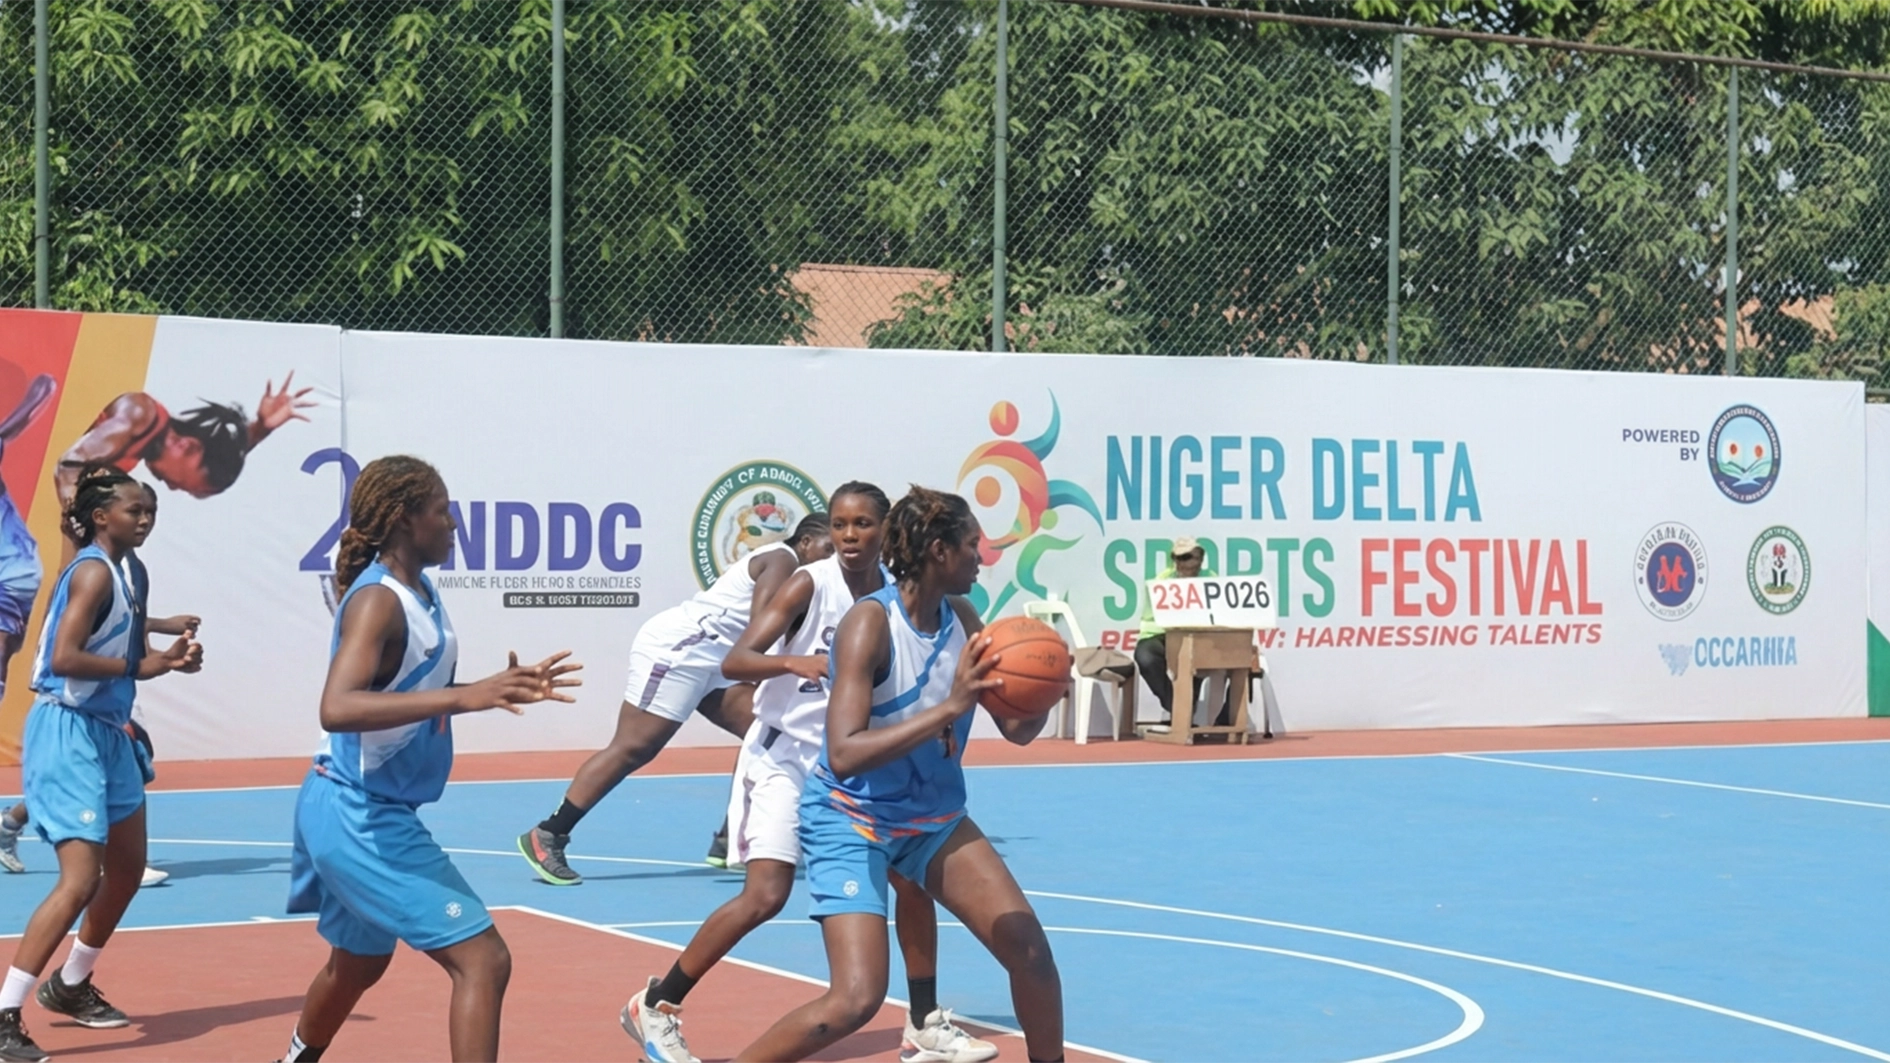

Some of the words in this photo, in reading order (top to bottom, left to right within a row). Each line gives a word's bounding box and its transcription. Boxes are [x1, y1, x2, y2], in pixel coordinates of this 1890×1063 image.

[1622, 428, 1700, 443] POWERED
[1680, 448, 1700, 461] BY
[1106, 434, 1288, 521] NIGER
[1311, 437, 1483, 522] DELTA
[440, 500, 643, 572] NDDC
[1361, 538, 1604, 618] FESTIVAL
[1295, 625, 1479, 648] HARNESSING
[1488, 623, 1603, 646] TALENTS
